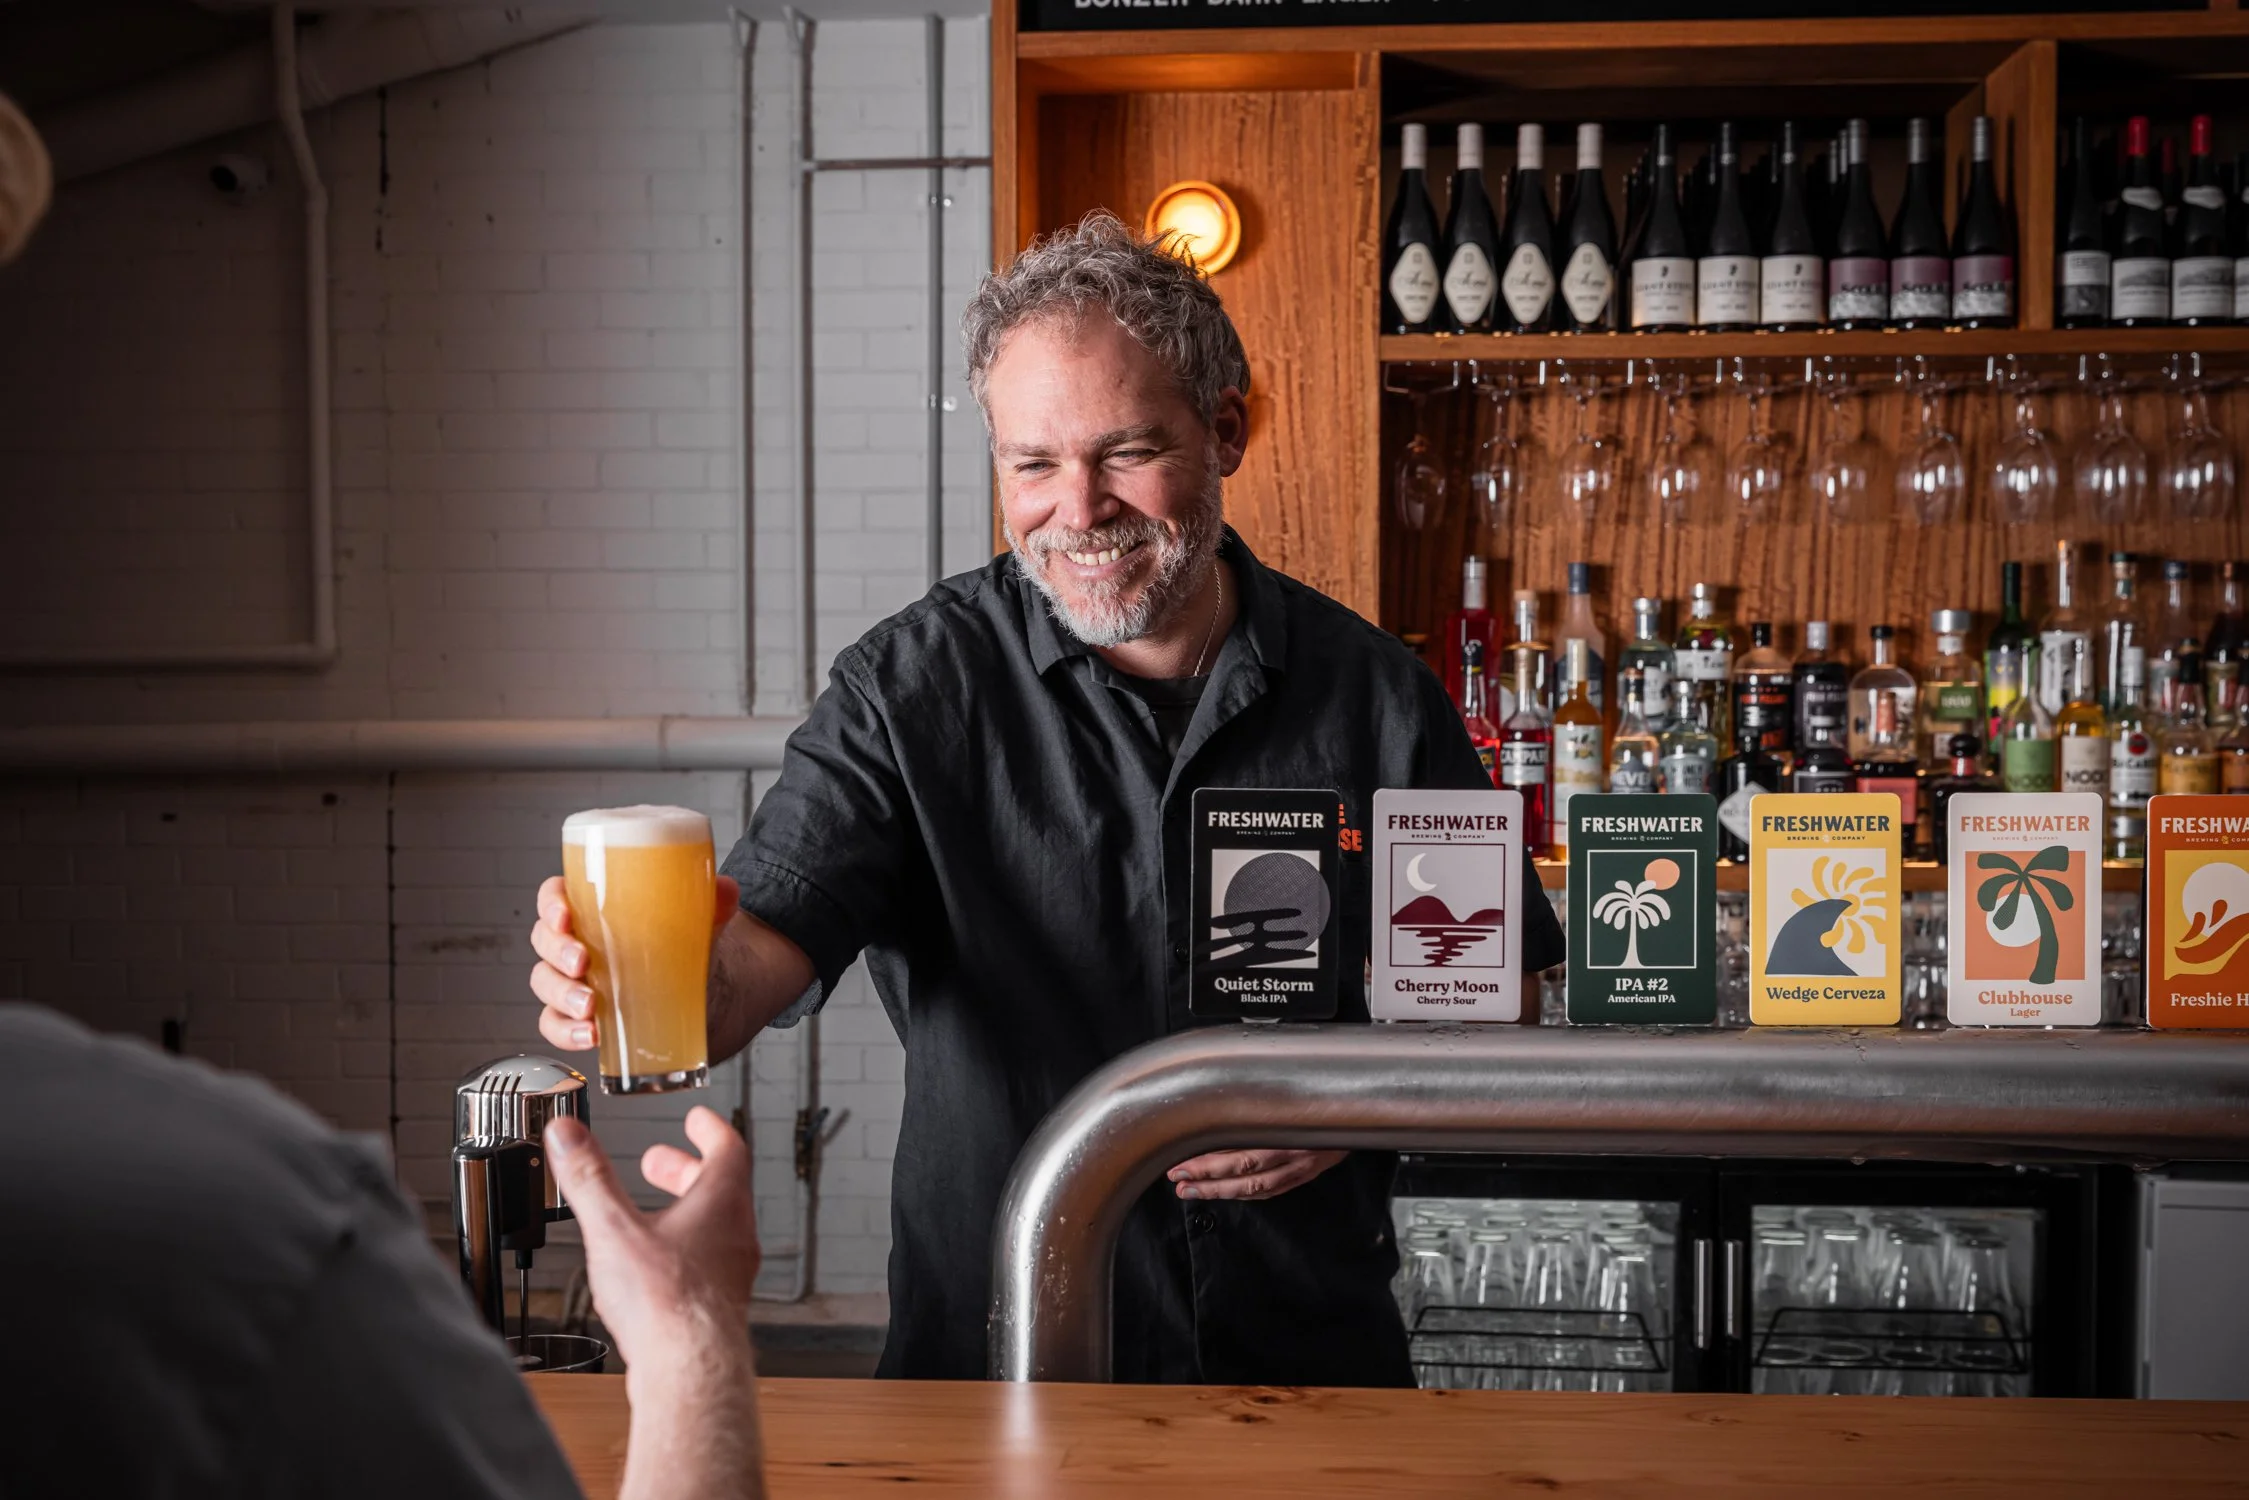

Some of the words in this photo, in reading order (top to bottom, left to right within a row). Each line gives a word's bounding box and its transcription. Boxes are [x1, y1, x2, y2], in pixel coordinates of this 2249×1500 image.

[1209, 812, 1323, 828] FRESHWATER
[1389, 815, 1507, 830] FRESHWATER
[1582, 817, 1702, 832] FRESHWATER
[1763, 816, 1889, 831] FRESHWATER
[1961, 816, 2089, 832] FRESHWATER
[1215, 977, 1259, 993] Quiet
[1263, 978, 1313, 991] Storm
[1395, 979, 1449, 995] Cherry
[1454, 980, 1498, 992] Moon
[1616, 978, 1644, 990] IPA
[1647, 978, 1668, 990] #2
[1240, 993, 1269, 1003] Black
[1417, 996, 1450, 1006] Cherry
[1608, 994, 1656, 1002] American
[1766, 987, 1819, 1002] Wedge
[1823, 987, 1885, 999] Cerveza
[1978, 990, 2073, 1005] Clubhouse
[2171, 992, 2231, 1006] Freshie
[2011, 1008, 2041, 1018] Lager
